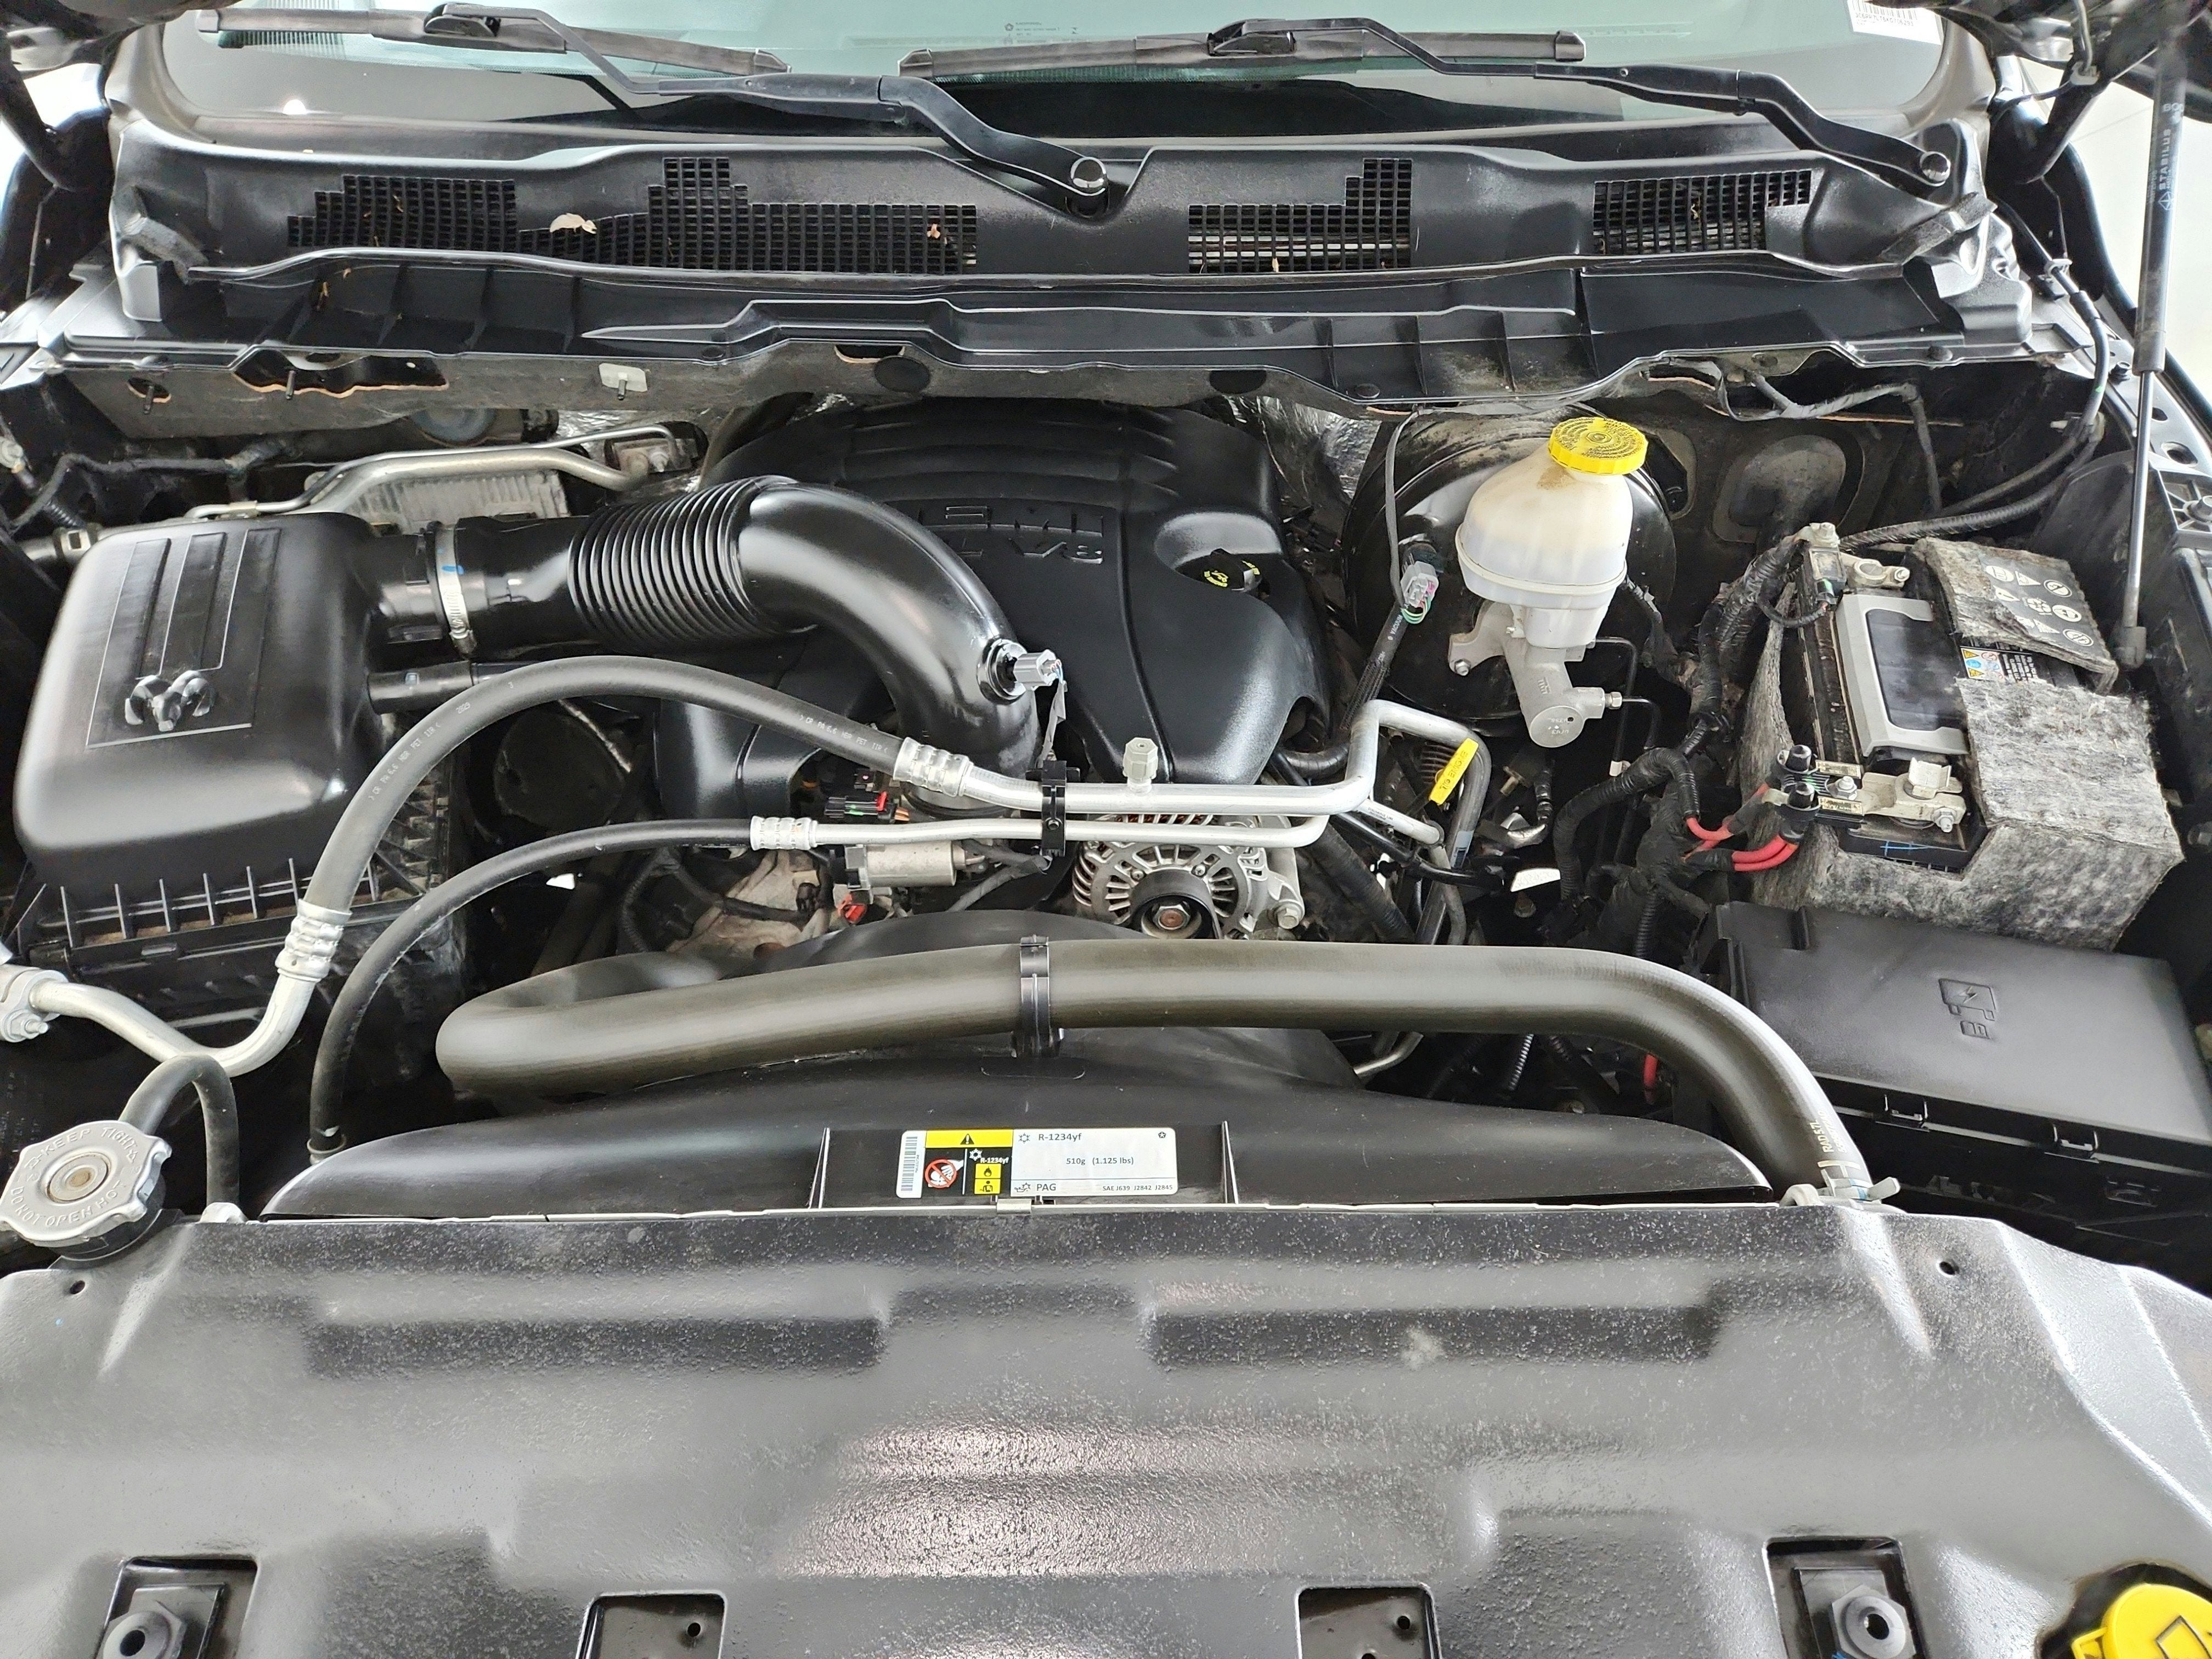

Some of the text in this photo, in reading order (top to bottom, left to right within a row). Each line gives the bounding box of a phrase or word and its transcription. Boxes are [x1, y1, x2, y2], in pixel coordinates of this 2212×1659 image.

[2159, 128, 2171, 190] STABILUS
[1390, 614, 1403, 635] VACUUM
[856, 737, 867, 746] PET
[1440, 750, 1468, 790] ENGINE OIL
[42, 1127, 138, 1155] KEEP TIGHT
[1039, 1133, 1082, 1142] R-1234yf
[980, 1156, 1009, 1165] R-1234yf
[1066, 1156, 1135, 1166] 510g (1.125 lbs)
[1036, 1183, 1057, 1192] PAG
[13, 1180, 126, 1227] DO NOT OPEN HOT
